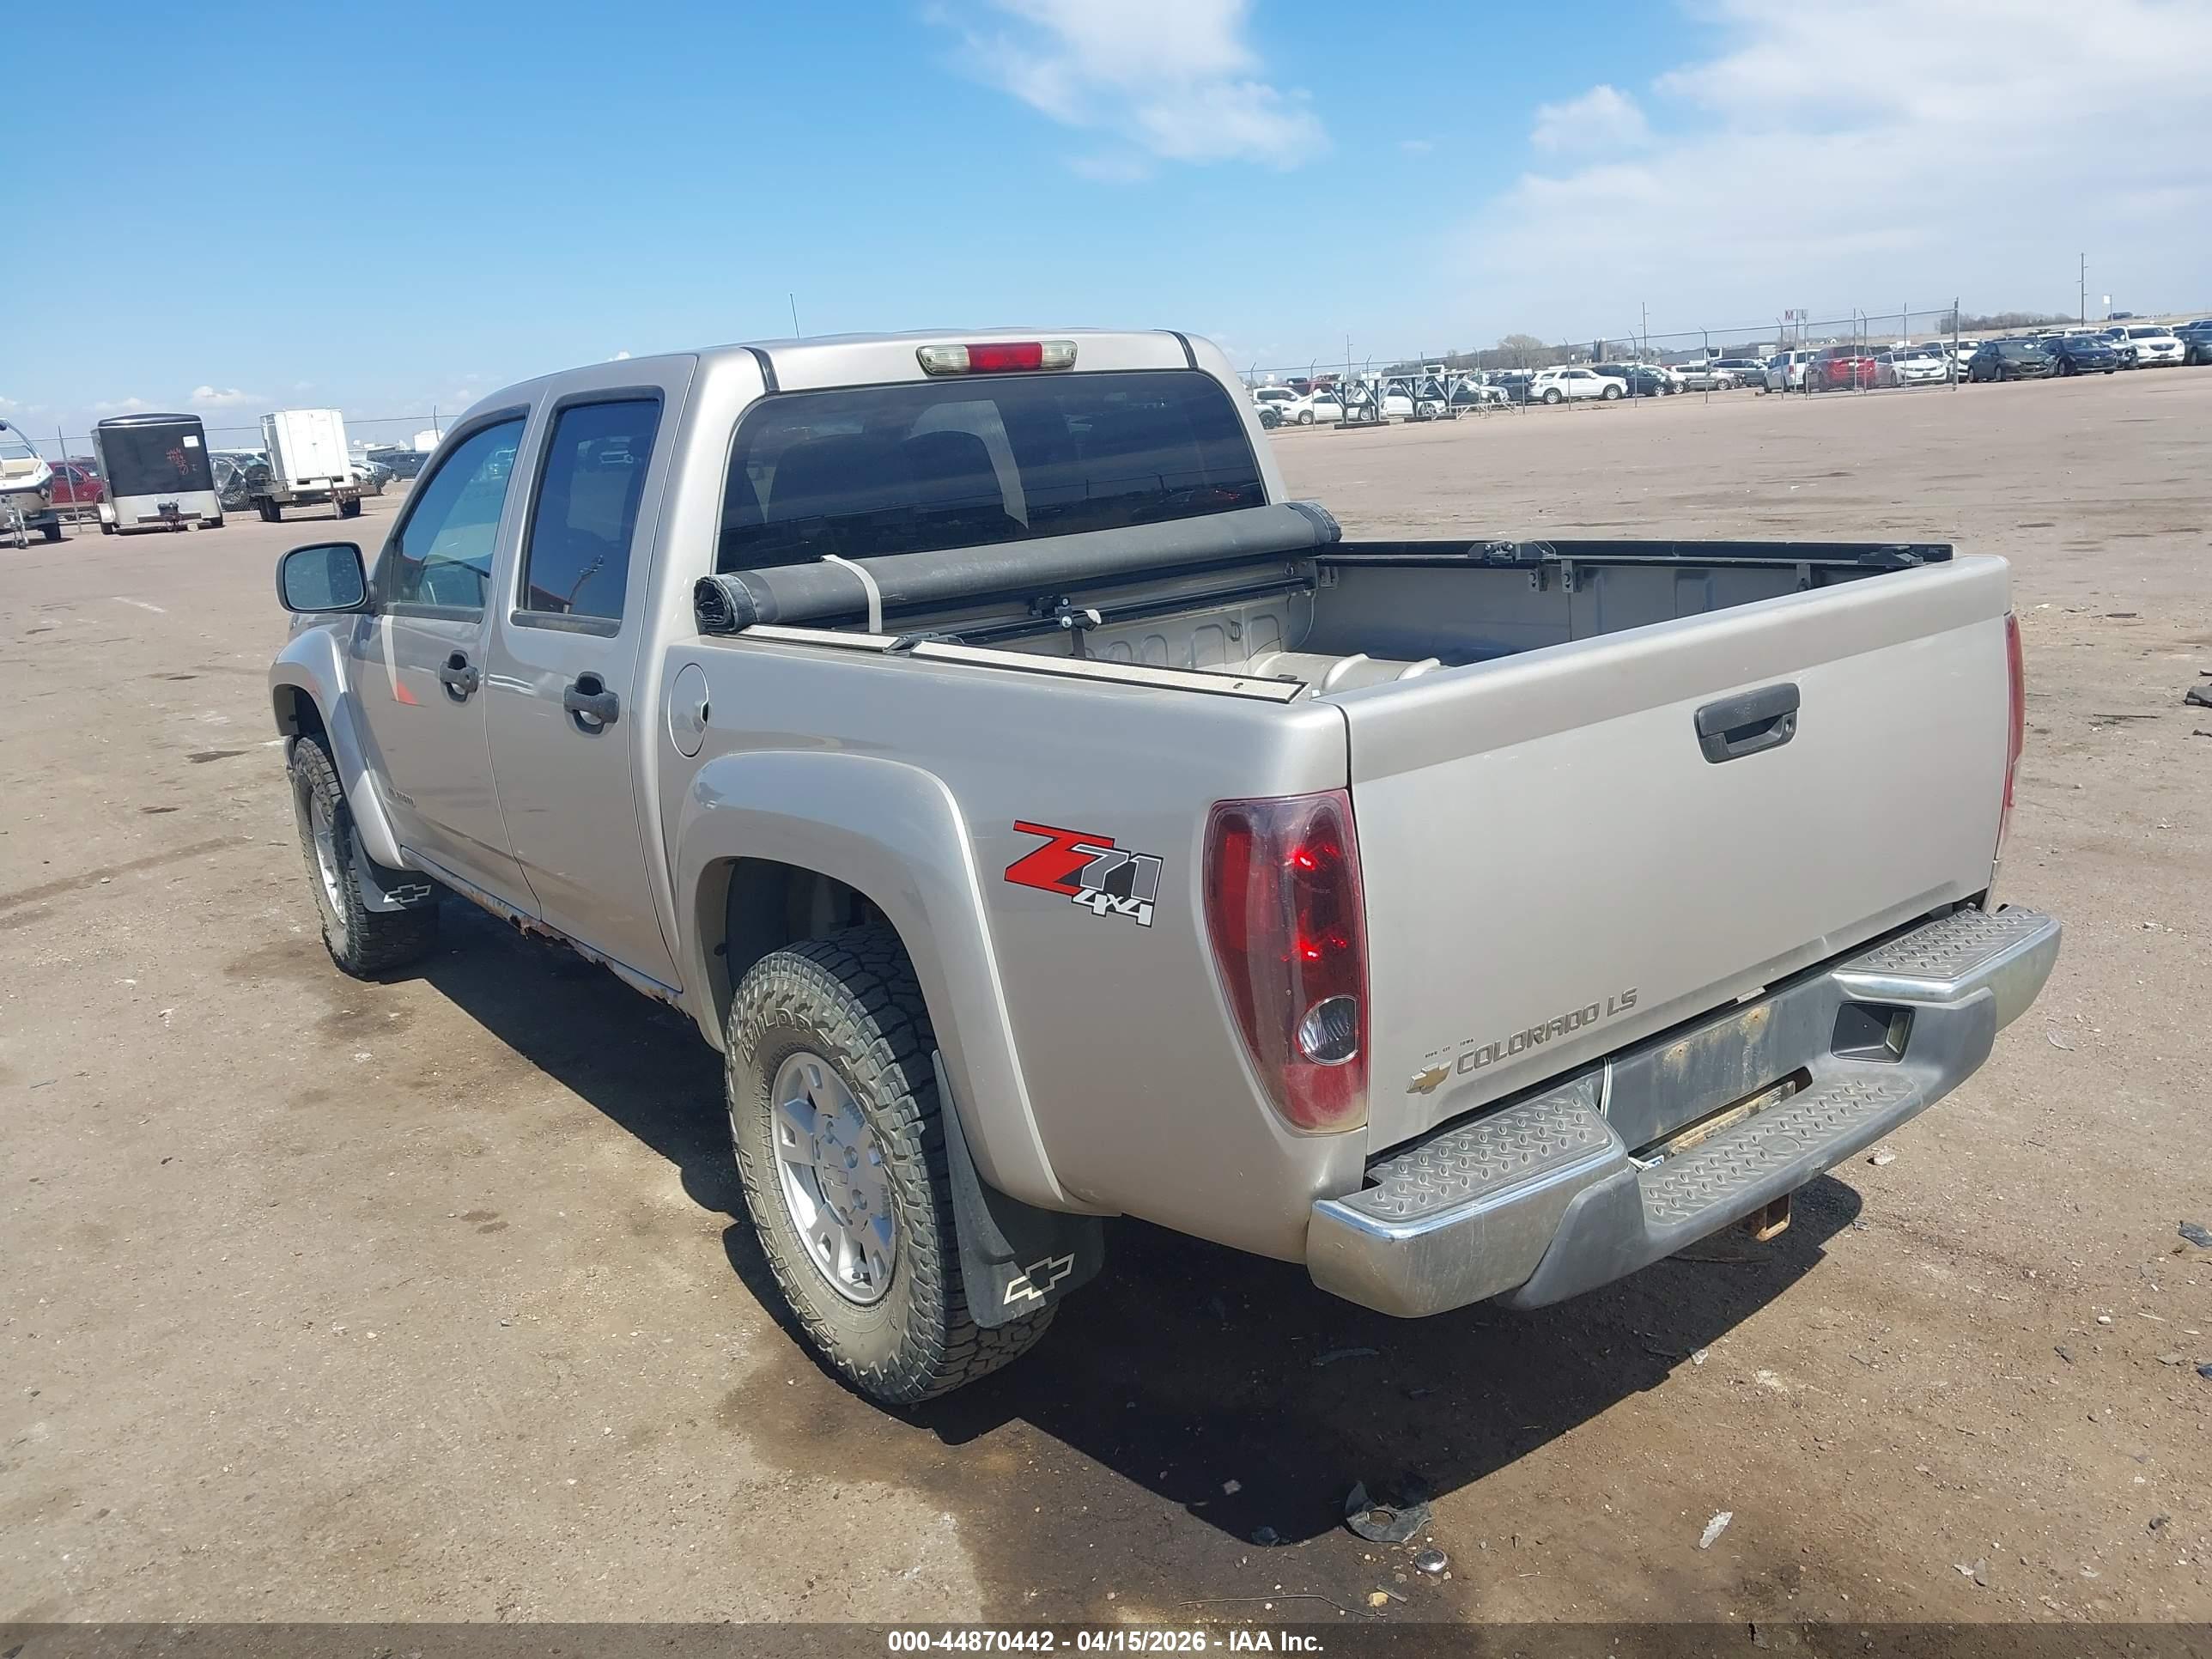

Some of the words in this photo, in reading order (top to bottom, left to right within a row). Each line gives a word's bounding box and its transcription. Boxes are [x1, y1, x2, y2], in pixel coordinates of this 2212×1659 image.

[1004, 819, 1164, 902] Z71
[1456, 1001, 1601, 1075] COLORADO
[1607, 987, 1638, 1018] LS
